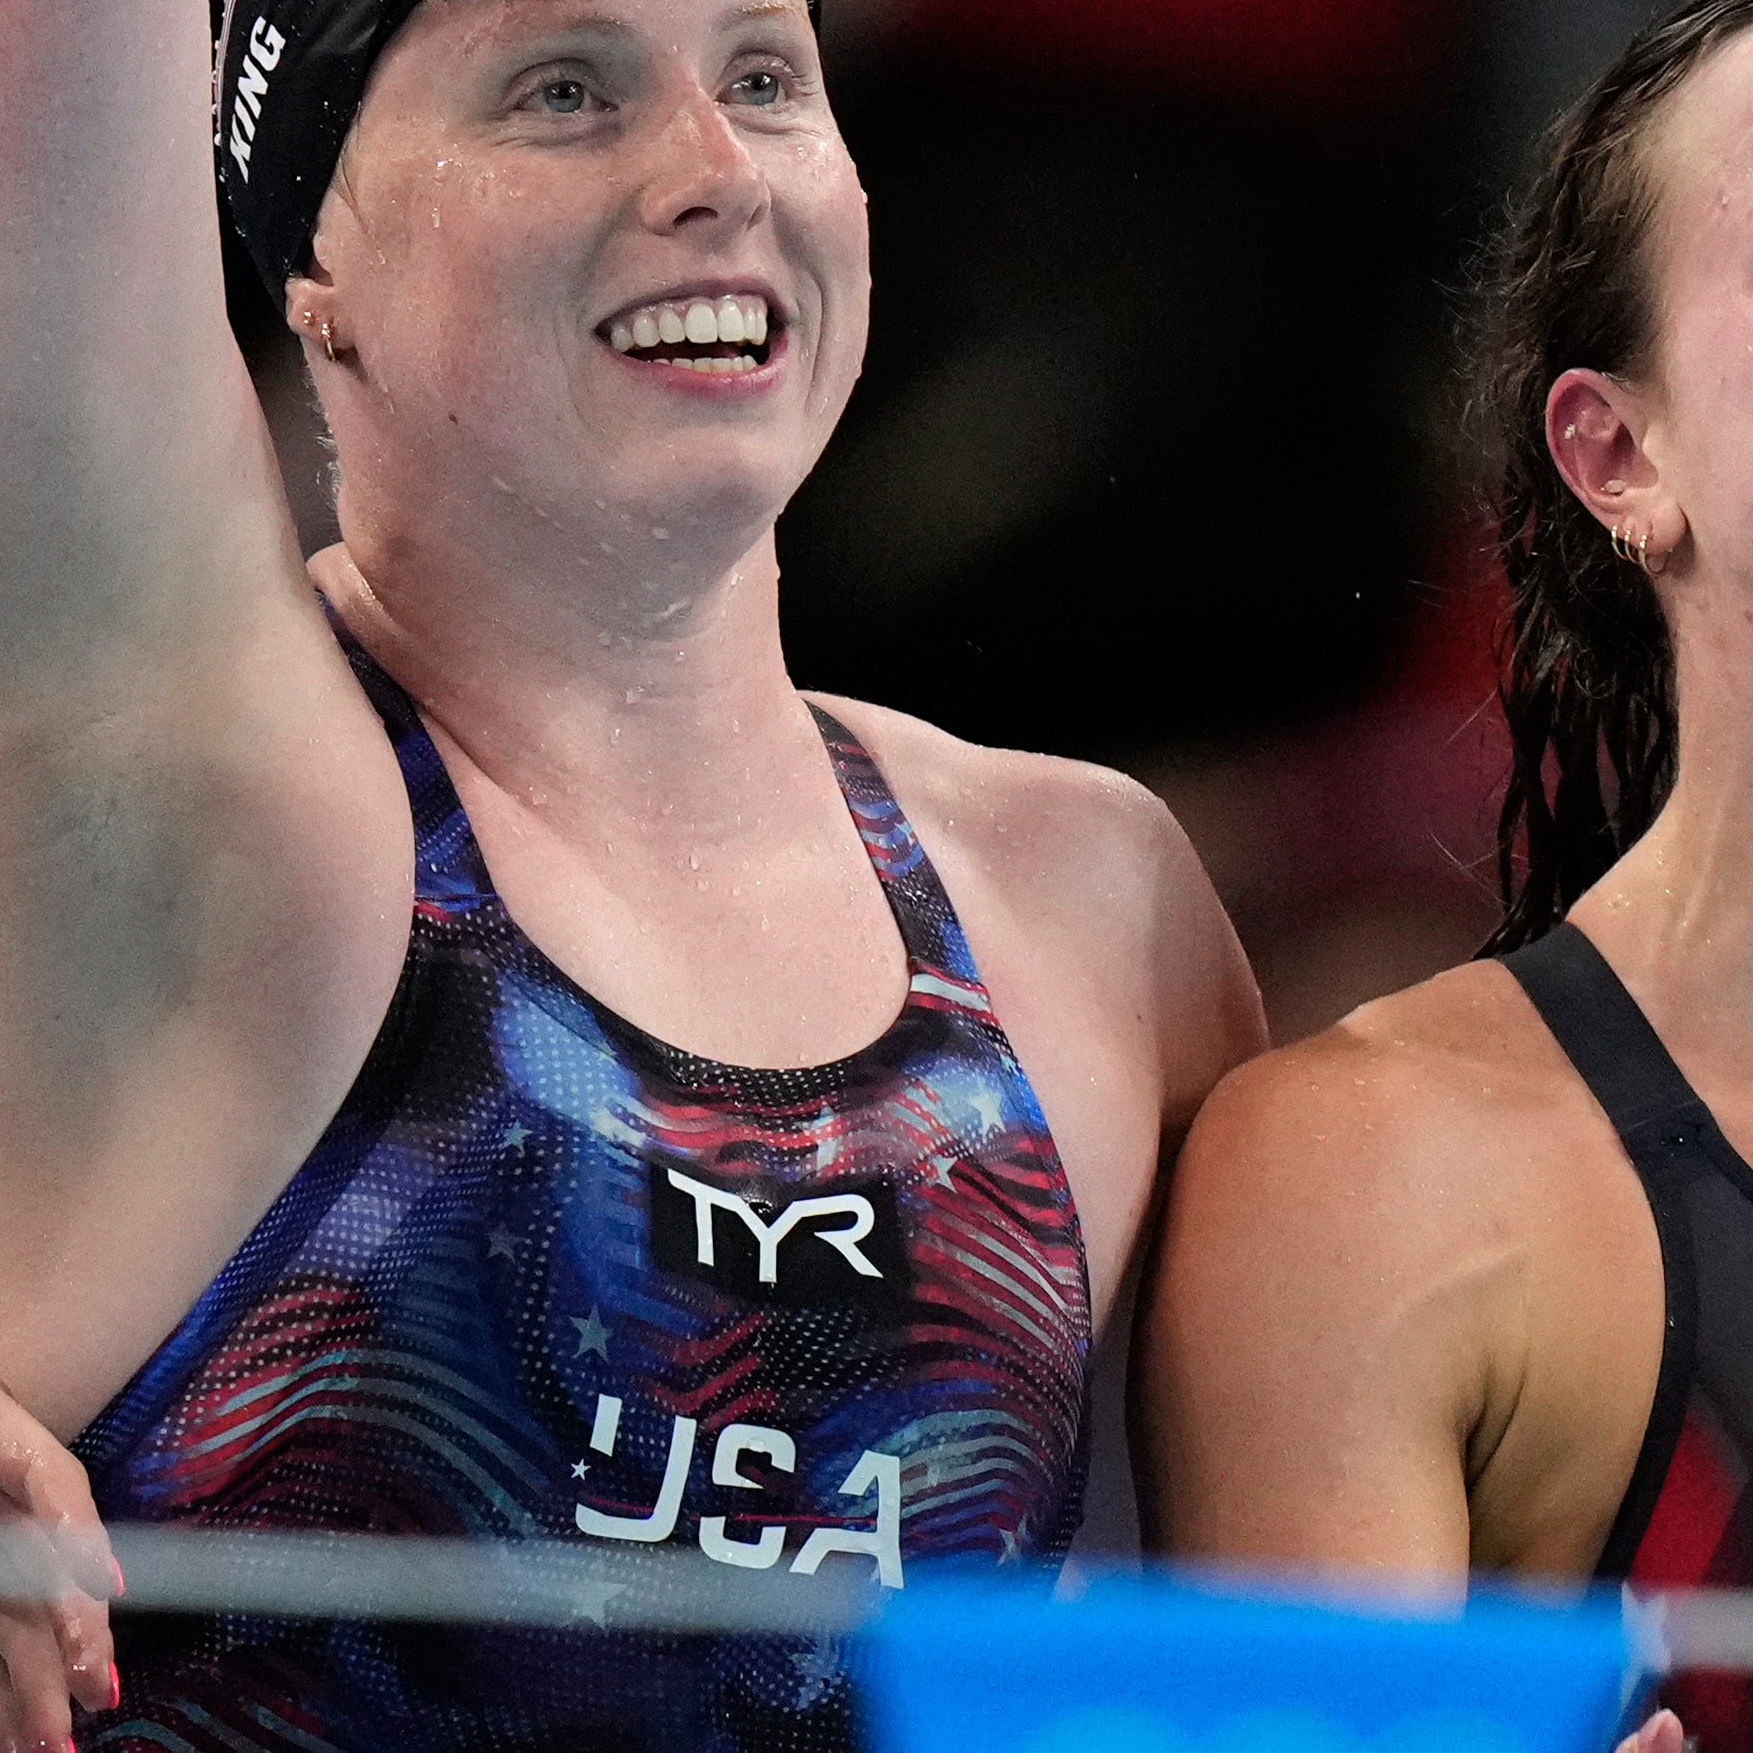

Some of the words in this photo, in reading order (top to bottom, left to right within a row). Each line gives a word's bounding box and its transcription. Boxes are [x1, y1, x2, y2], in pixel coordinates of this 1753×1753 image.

[230, 15, 287, 184] KING
[667, 1168, 884, 1283] TYR
[574, 1393, 904, 1589] USA
